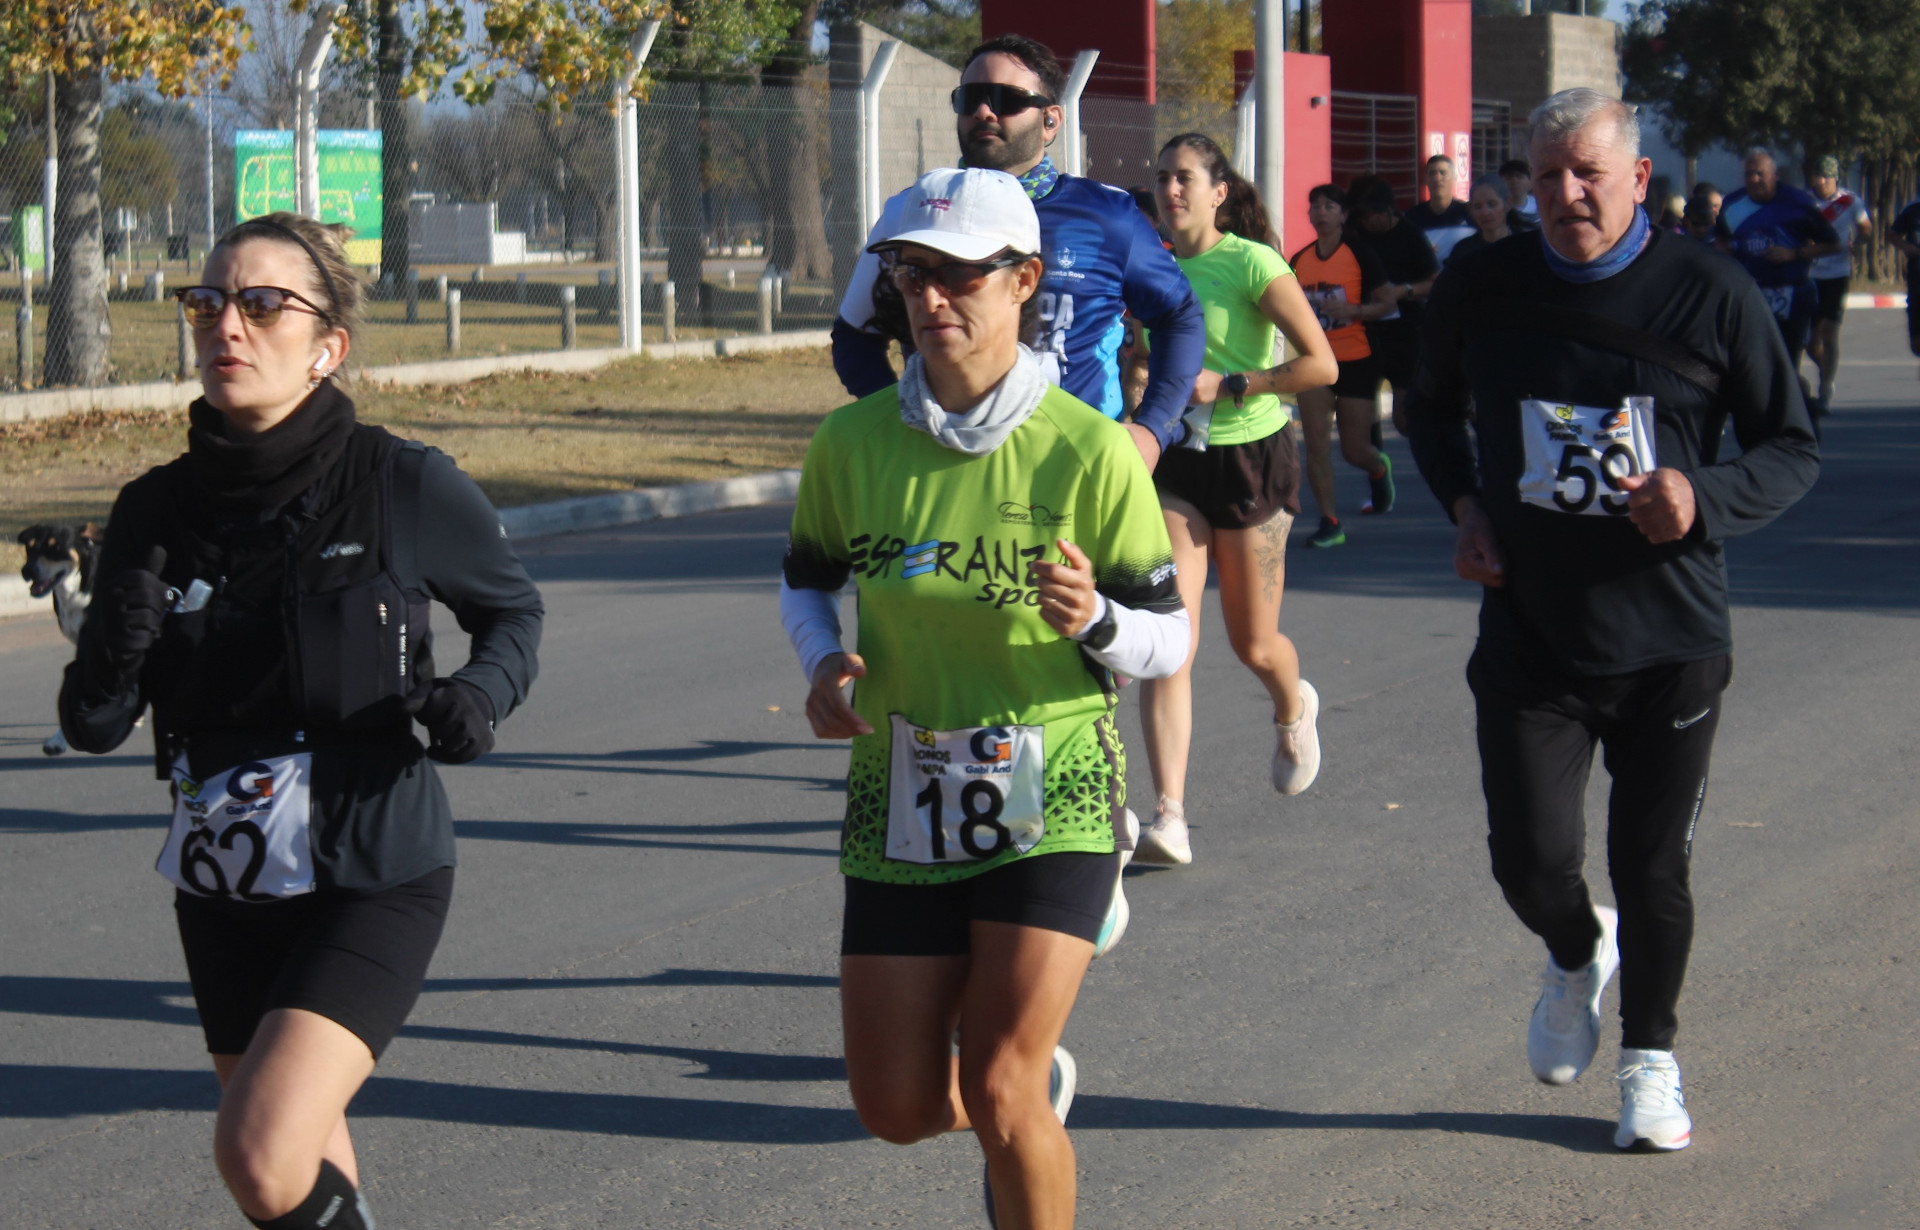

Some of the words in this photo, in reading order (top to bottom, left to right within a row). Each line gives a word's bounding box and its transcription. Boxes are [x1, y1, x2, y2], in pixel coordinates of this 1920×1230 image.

[1068, 271, 1085, 279] Rosa
[1553, 443, 1641, 515] 59
[850, 534, 1071, 586] ESPERANZ
[965, 765, 989, 774] Gabi
[992, 765, 1011, 774] And
[916, 778, 1010, 859] 18
[180, 820, 268, 899] 62
